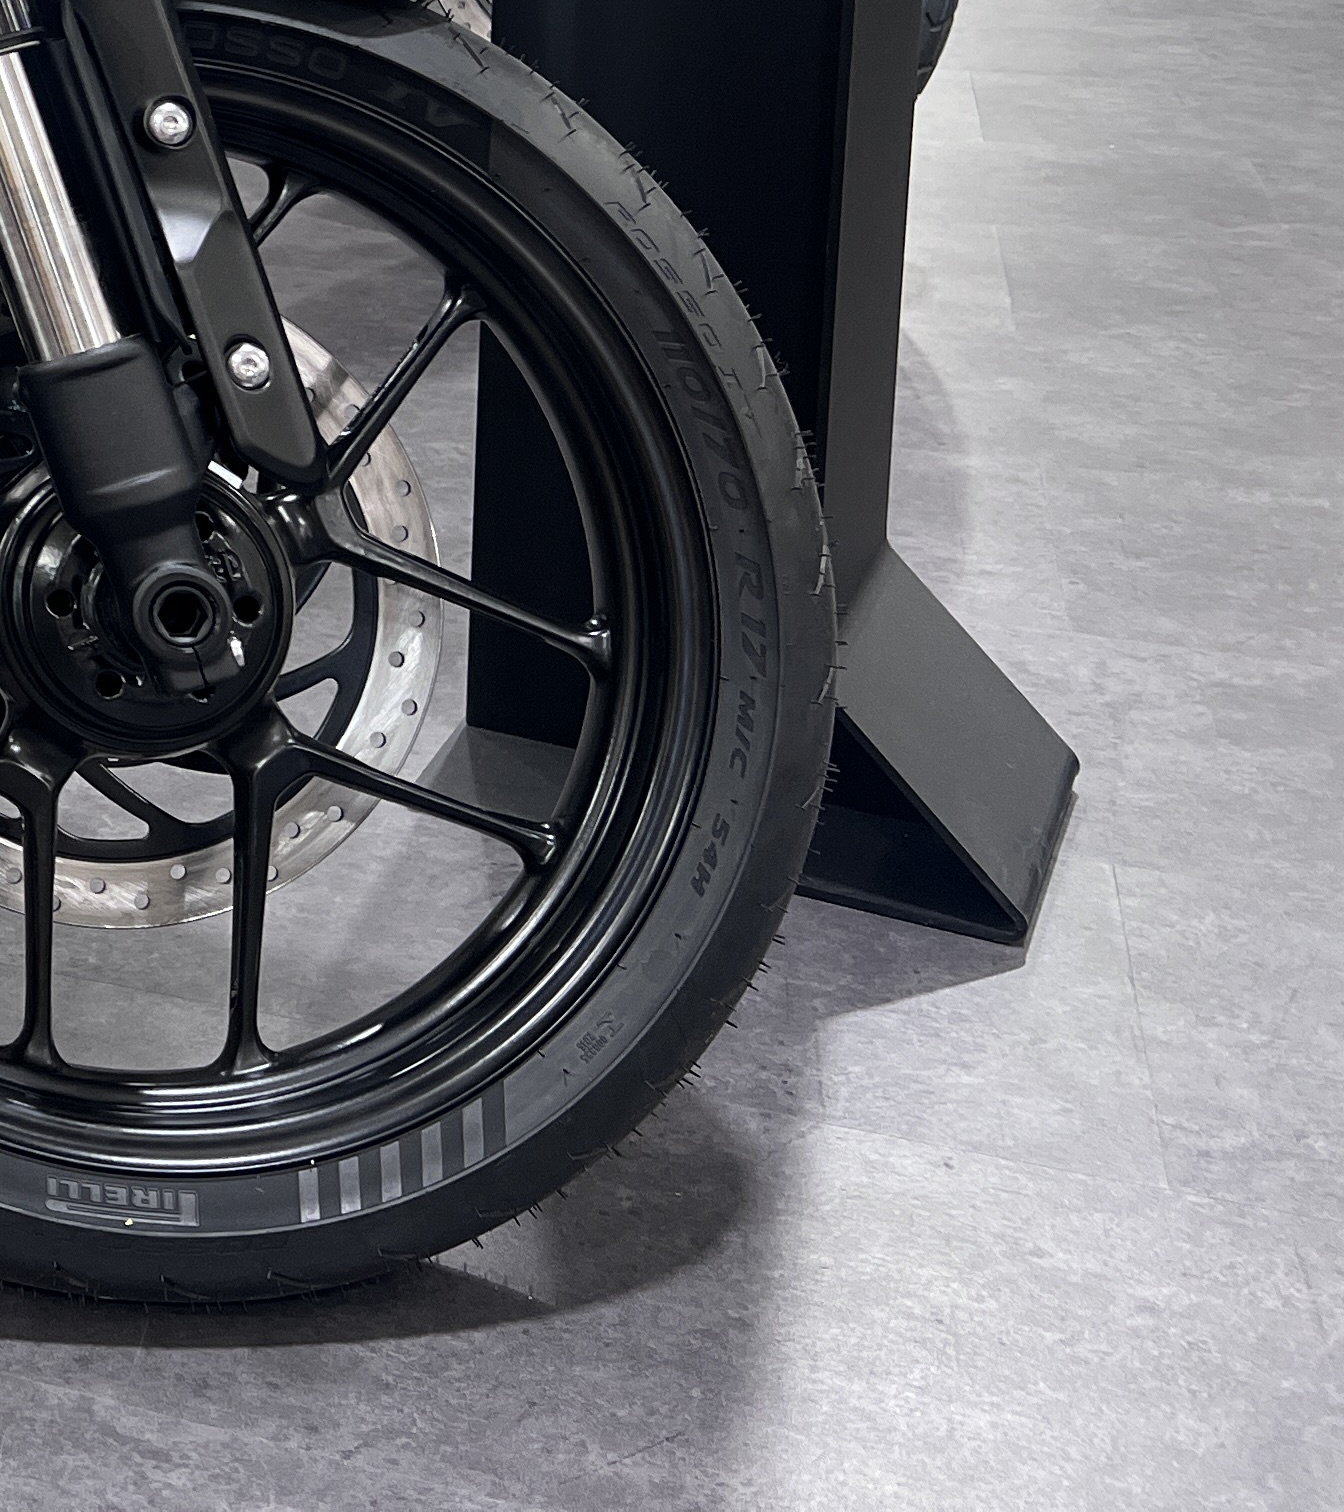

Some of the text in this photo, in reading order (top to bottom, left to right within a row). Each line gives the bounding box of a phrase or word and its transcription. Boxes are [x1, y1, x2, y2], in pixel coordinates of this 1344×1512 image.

[182, 19, 348, 81] OSSO
[688, 813, 732, 899] 54H
[45, 1174, 200, 1228] PIRELLI
